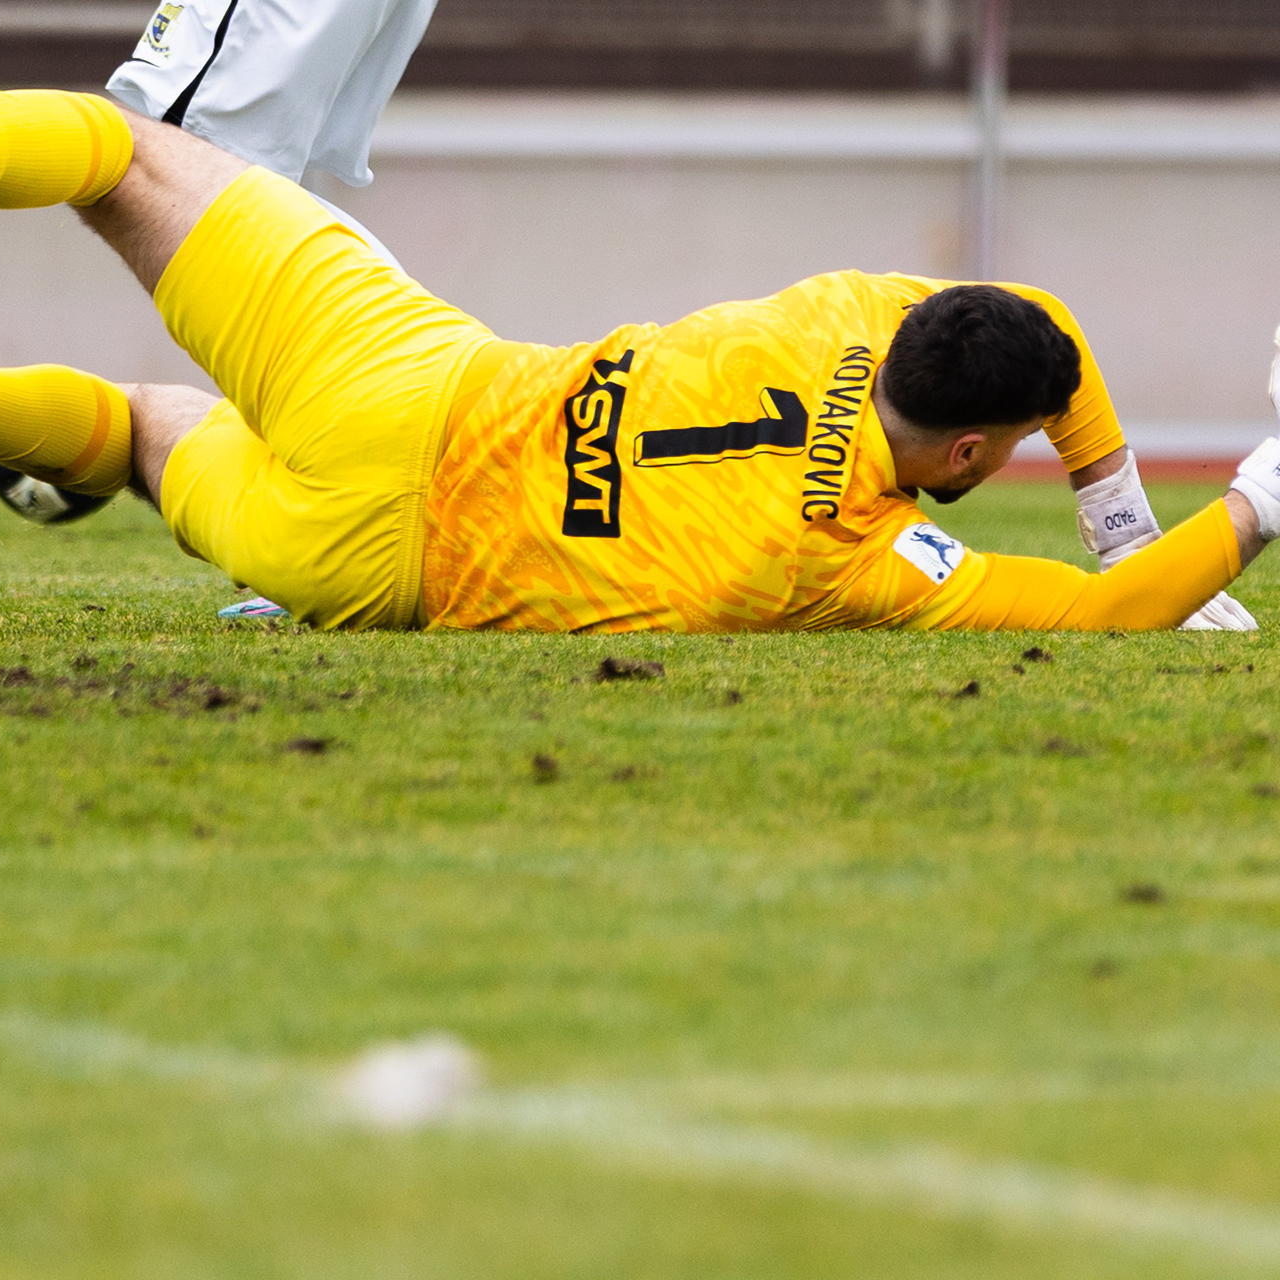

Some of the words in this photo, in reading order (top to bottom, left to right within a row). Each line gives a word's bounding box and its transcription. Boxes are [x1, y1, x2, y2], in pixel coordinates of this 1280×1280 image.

[633, 386, 809, 467] 1
[802, 345, 876, 522] NOVAKOVIC
[1104, 508, 1137, 531] RADO
